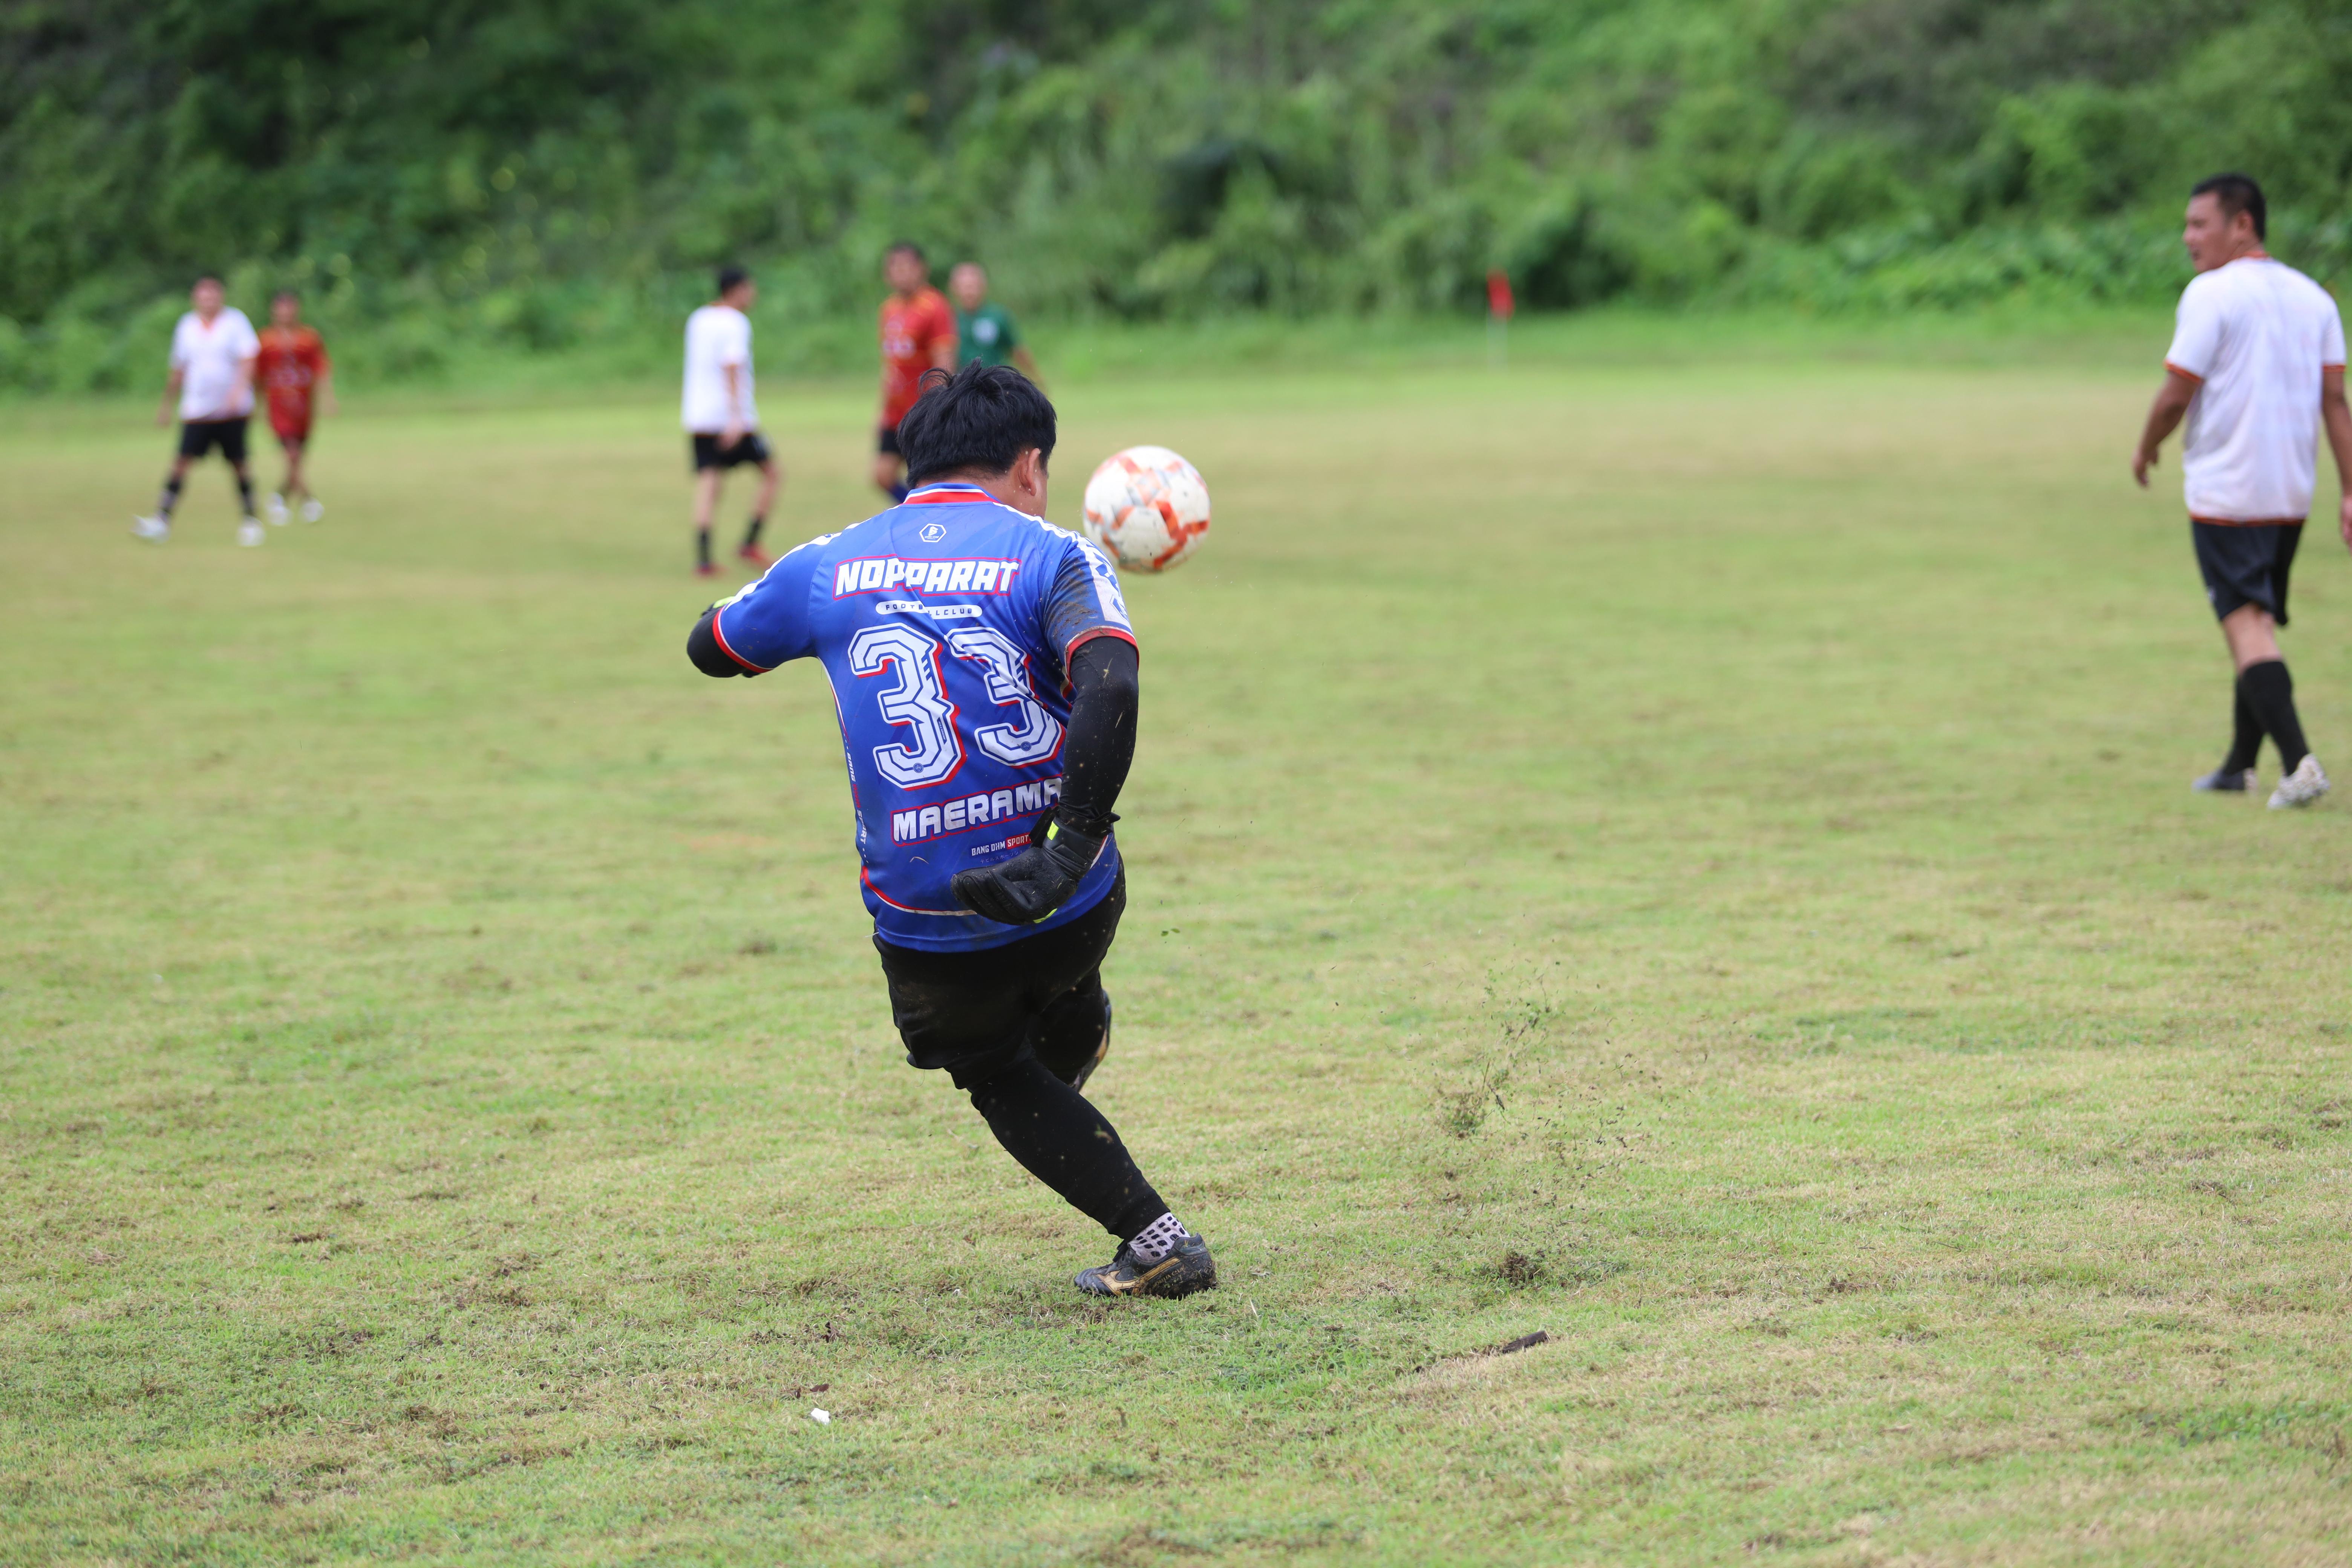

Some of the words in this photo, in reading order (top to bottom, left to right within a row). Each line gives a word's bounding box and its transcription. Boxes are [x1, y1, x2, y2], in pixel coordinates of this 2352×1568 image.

[835, 557, 1019, 596] NOPPARAT
[886, 603, 972, 616] FOOTBLLCLUB
[848, 622, 1067, 791] 33
[893, 777, 1062, 842] MAERAMA
[971, 845, 989, 856] BANG
[1007, 834, 1031, 847] SPORT
